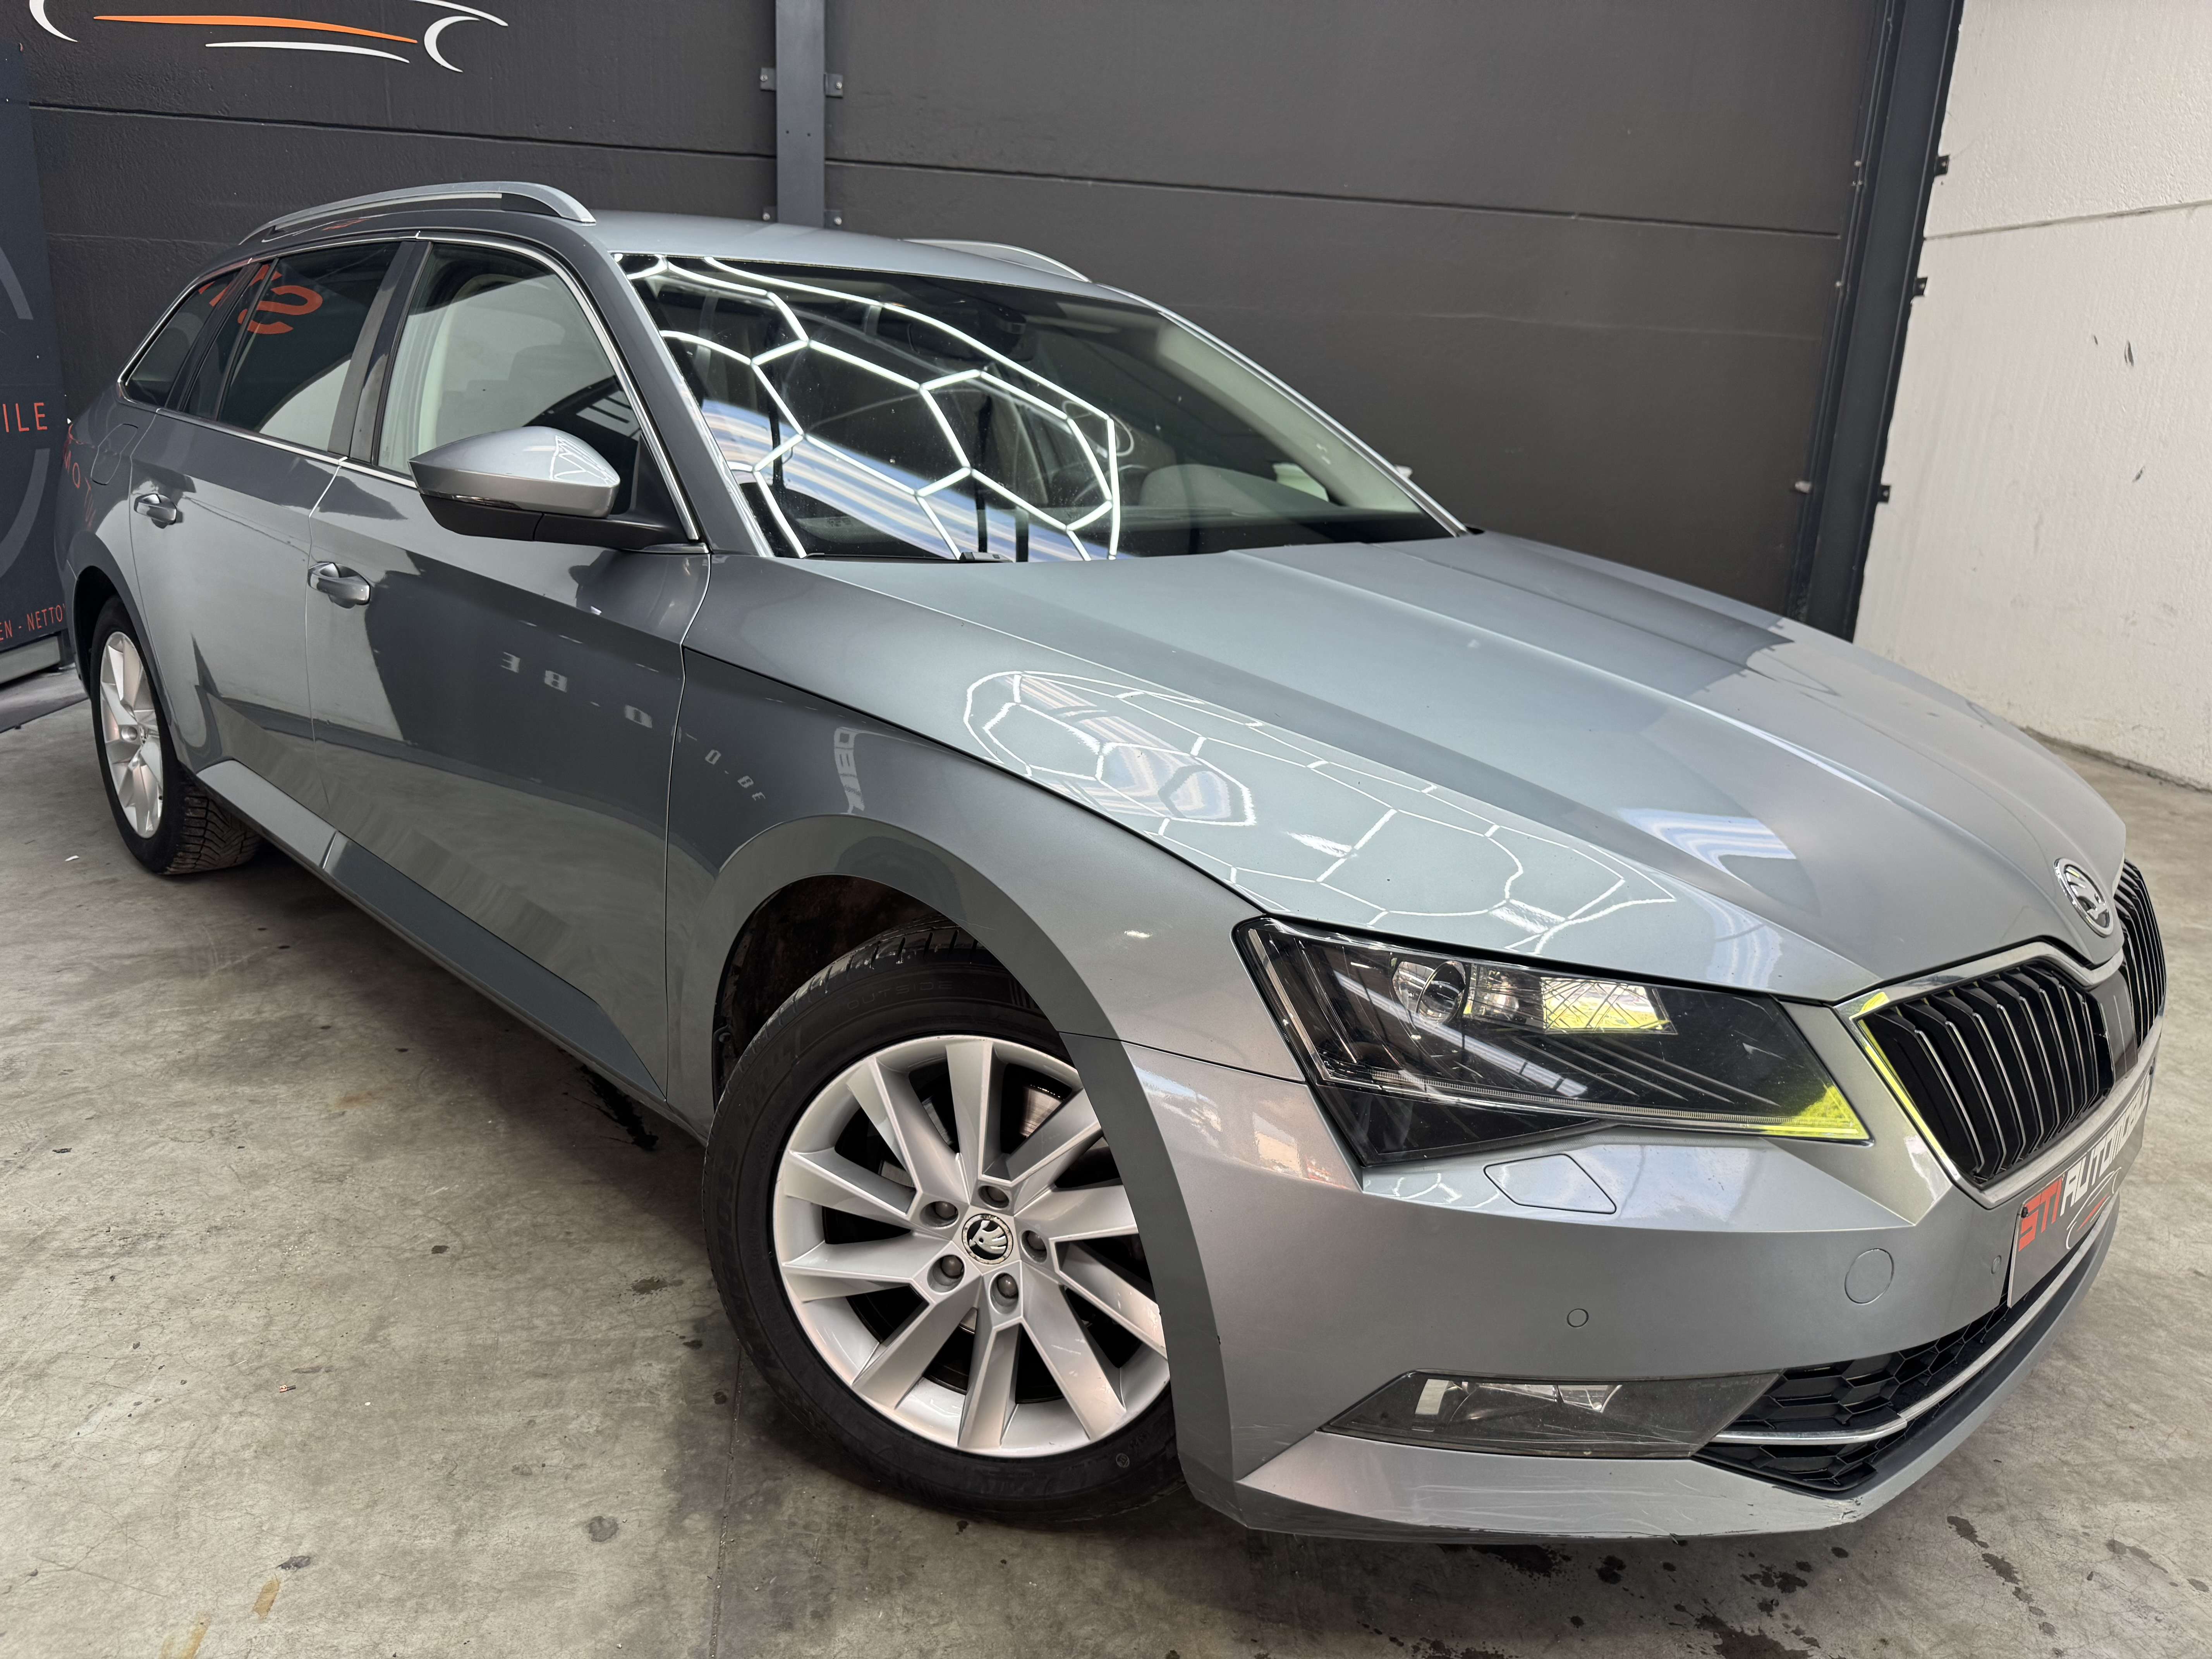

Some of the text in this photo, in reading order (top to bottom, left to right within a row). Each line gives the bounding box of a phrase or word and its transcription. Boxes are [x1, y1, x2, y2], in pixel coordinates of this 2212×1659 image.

[27, 603, 65, 632] NETTO
[847, 979, 954, 1012] OUTSIDE
[2018, 1176, 2063, 1252] STI
